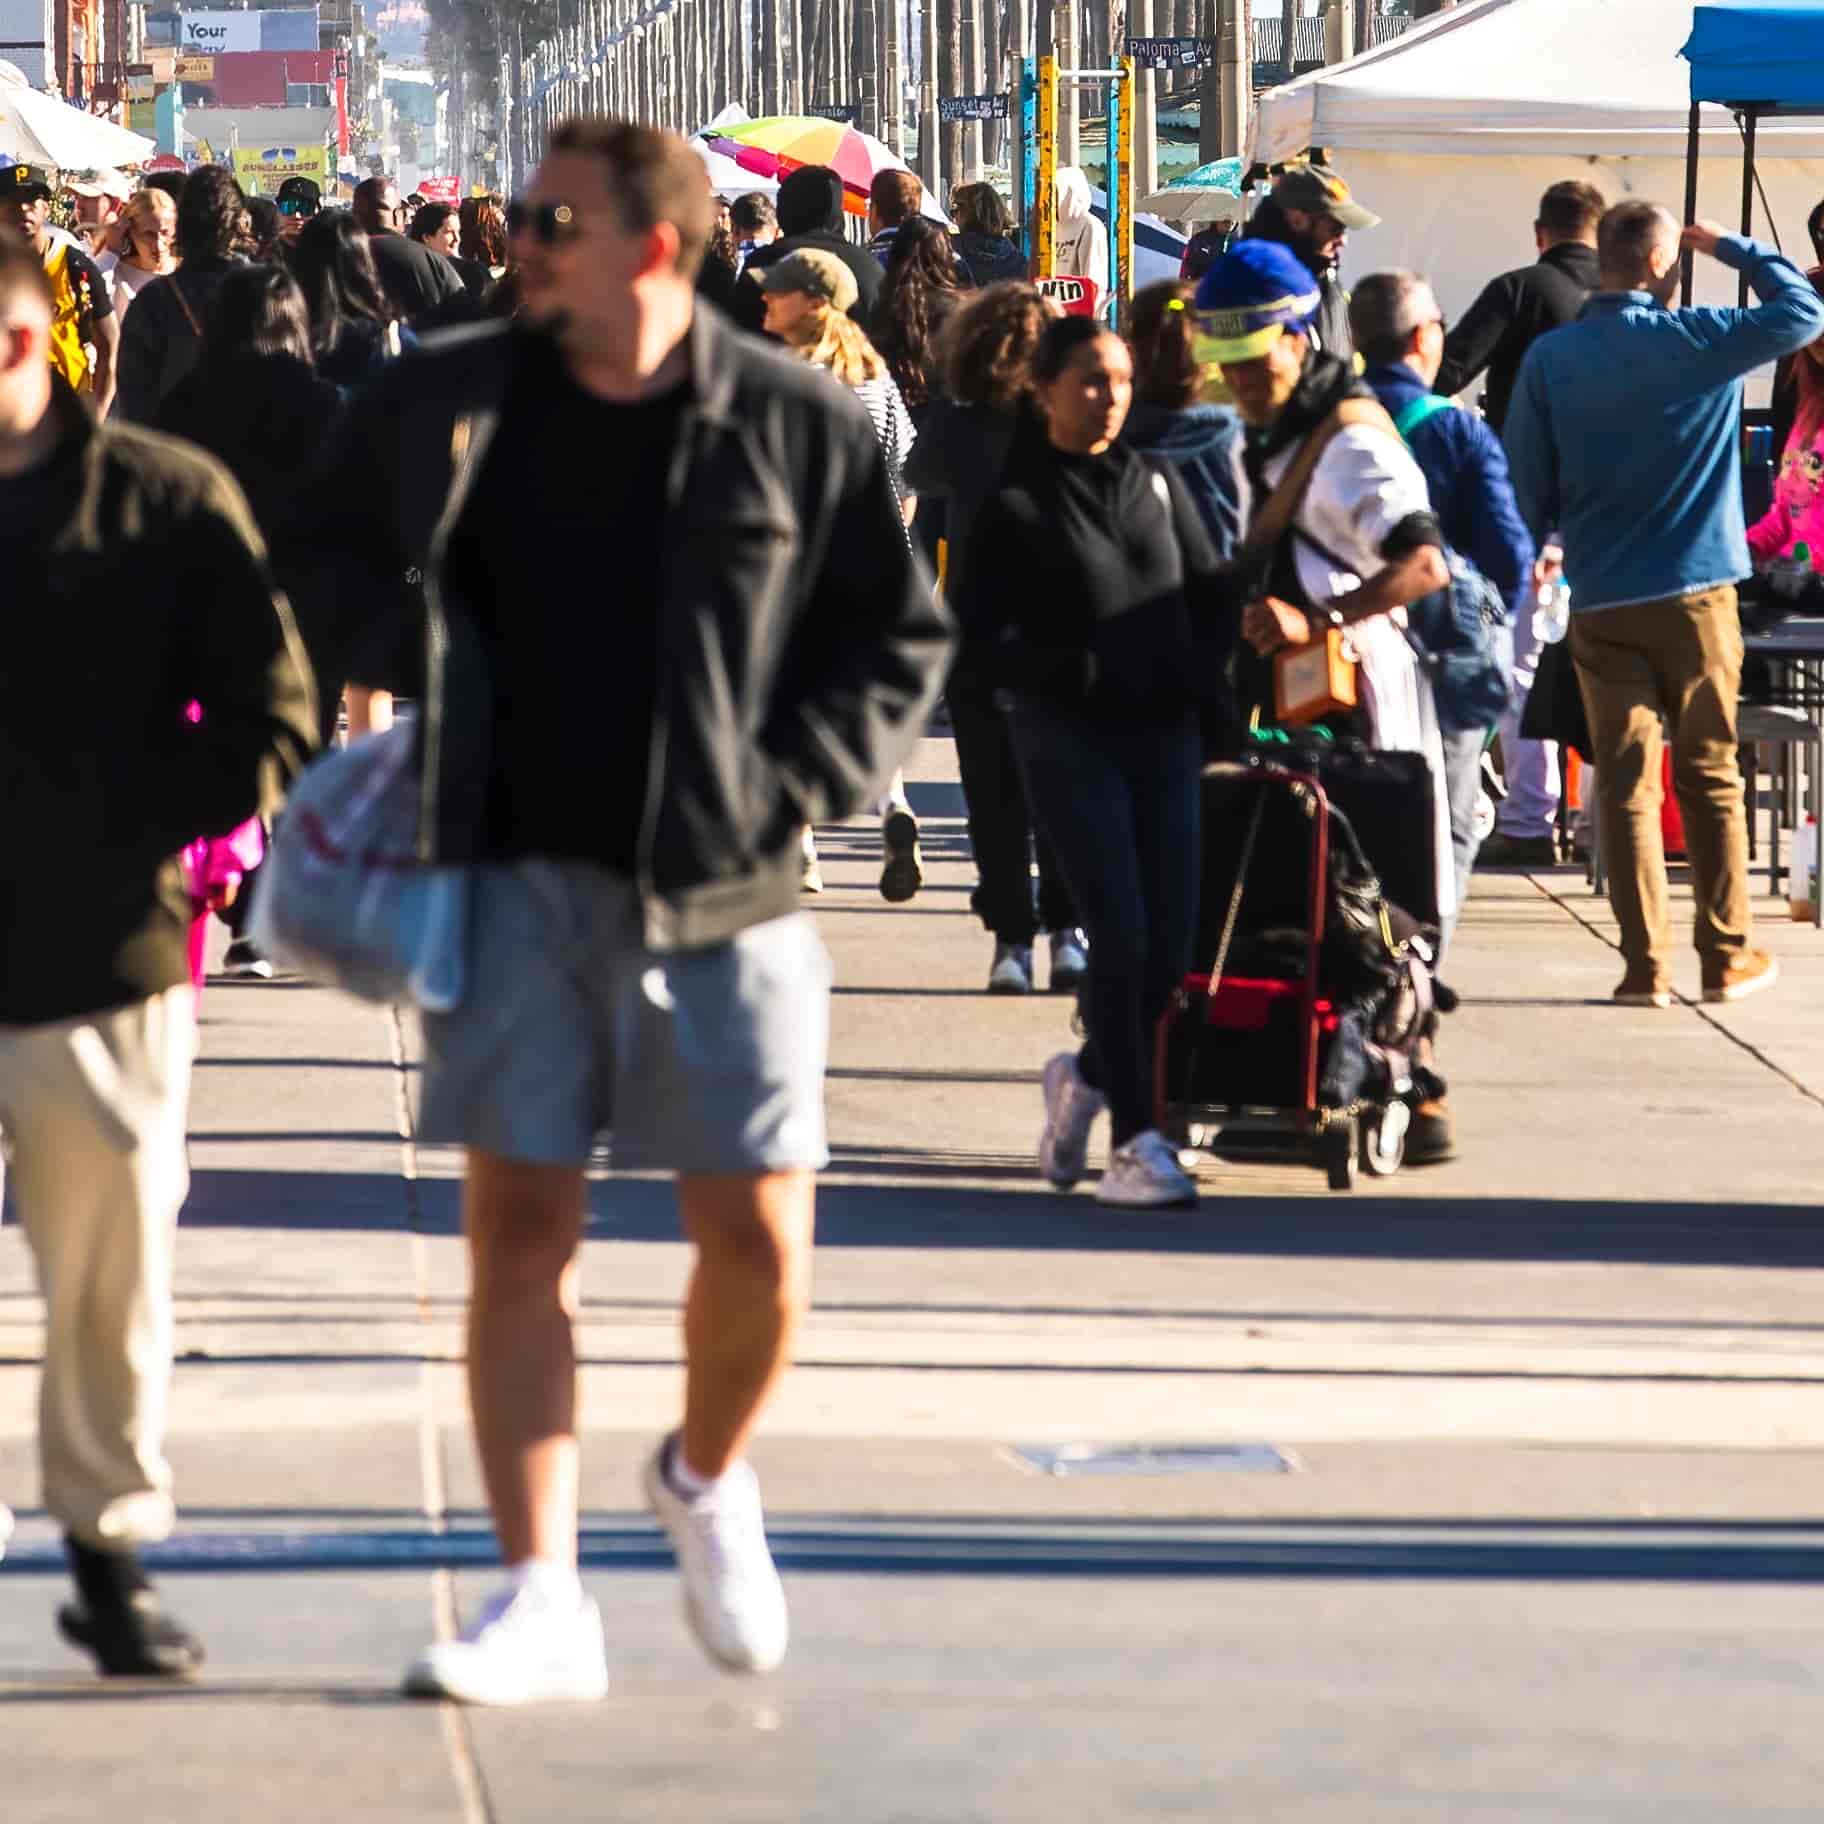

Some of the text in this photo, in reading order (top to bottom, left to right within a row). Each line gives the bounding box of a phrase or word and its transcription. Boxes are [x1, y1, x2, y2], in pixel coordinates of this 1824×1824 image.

[188, 23, 227, 38] Your
[1129, 40, 1211, 57] Paloma Av
[941, 97, 977, 112] Sunset
[15, 166, 29, 183] P
